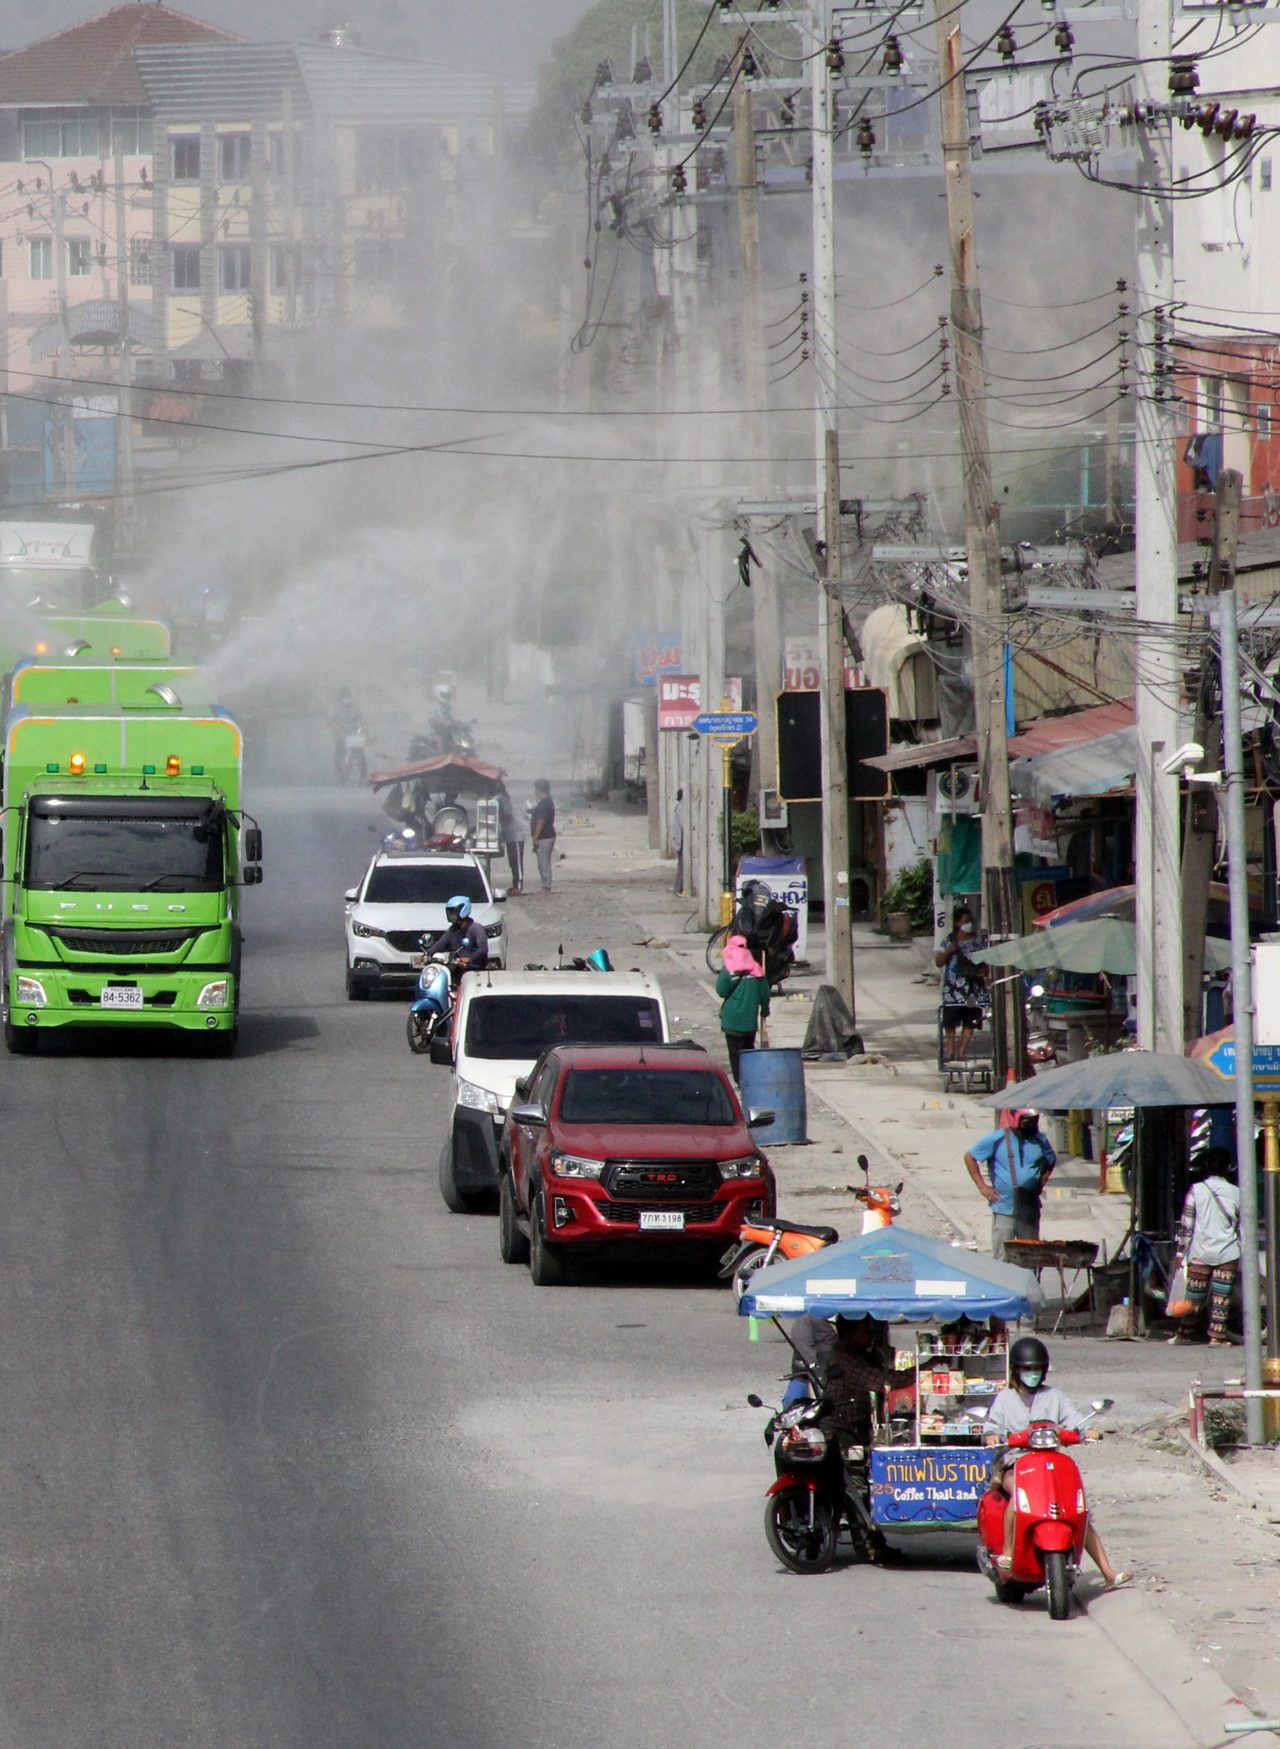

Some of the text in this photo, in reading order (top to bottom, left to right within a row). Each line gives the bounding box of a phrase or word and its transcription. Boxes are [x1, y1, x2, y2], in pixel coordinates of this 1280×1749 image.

[60, 902, 185, 912] FUSO
[103, 991, 141, 1003] 84-5362
[647, 1174, 677, 1182] TRD
[885, 1456, 987, 1483] กาแฟโบราณ
[894, 1486, 925, 1502] Coffee
